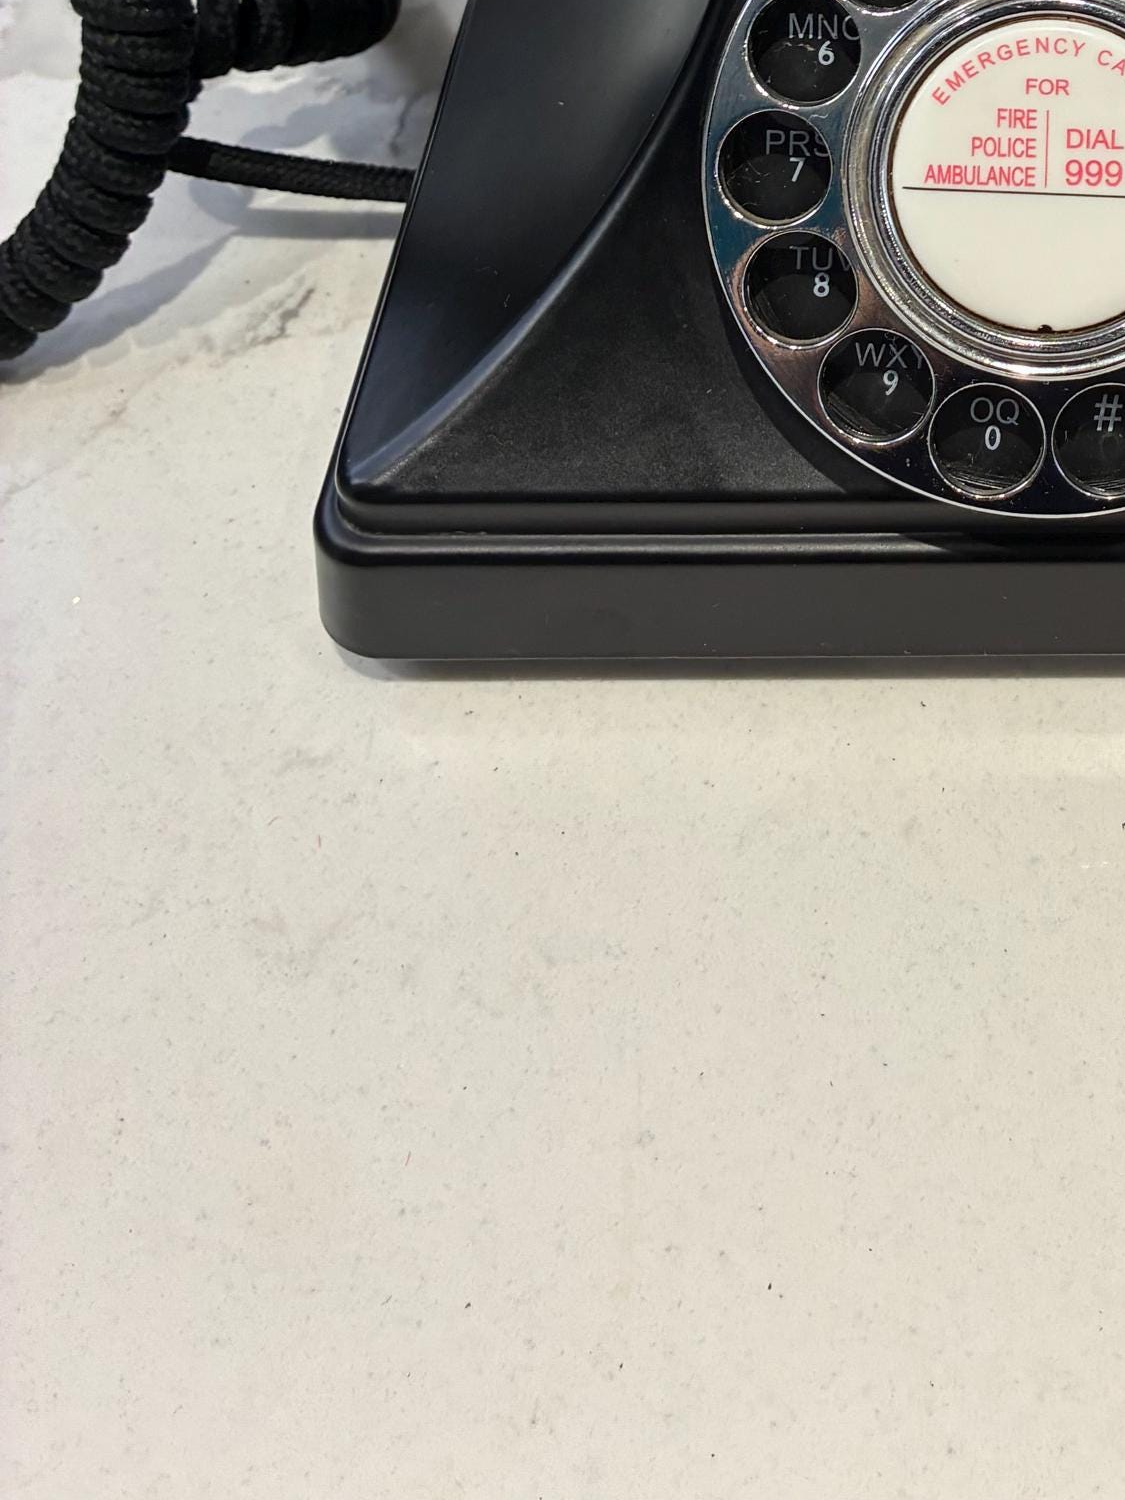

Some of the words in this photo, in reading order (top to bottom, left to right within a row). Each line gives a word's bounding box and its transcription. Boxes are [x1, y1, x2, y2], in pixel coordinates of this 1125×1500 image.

[818, 40, 835, 66] 6
[931, 37, 1086, 106] EMERGENCY
[1025, 78, 1070, 96] FOR
[997, 108, 1038, 130] FIRE
[971, 137, 1036, 158] POLICE
[1066, 128, 1125, 150] DIAL
[789, 157, 806, 182] 7
[924, 164, 1036, 187] AMBULANCE
[1065, 159, 1124, 187] 999
[813, 272, 830, 298] 8
[883, 369, 899, 396] 9
[970, 397, 1019, 426] OQ
[985, 425, 1001, 451] 0
